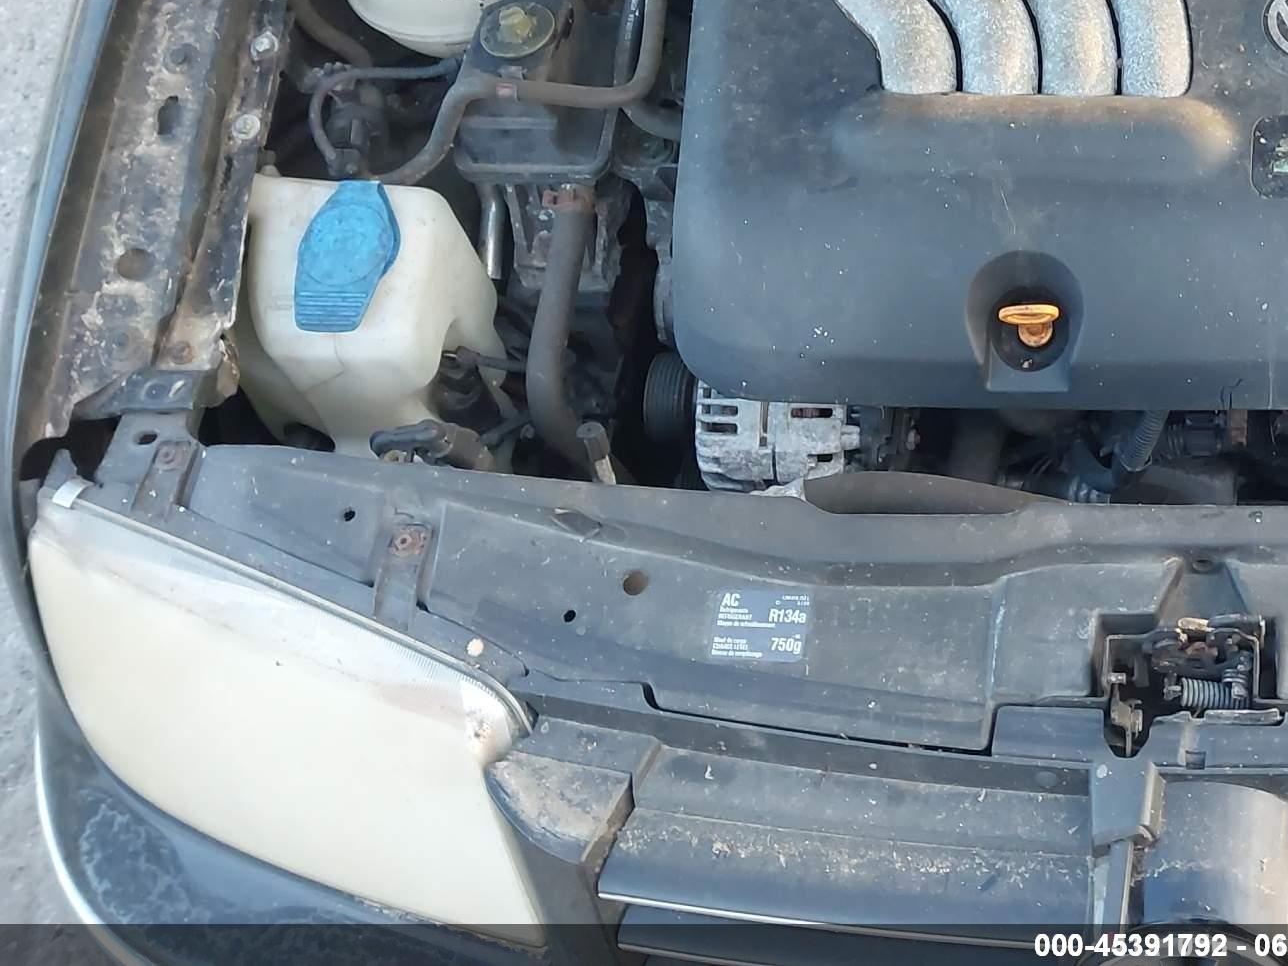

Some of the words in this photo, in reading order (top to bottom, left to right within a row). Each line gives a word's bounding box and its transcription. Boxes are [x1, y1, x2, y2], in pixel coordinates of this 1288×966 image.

[721, 592, 741, 607] AC
[768, 609, 807, 624] R134a
[771, 637, 802, 654] 750g
